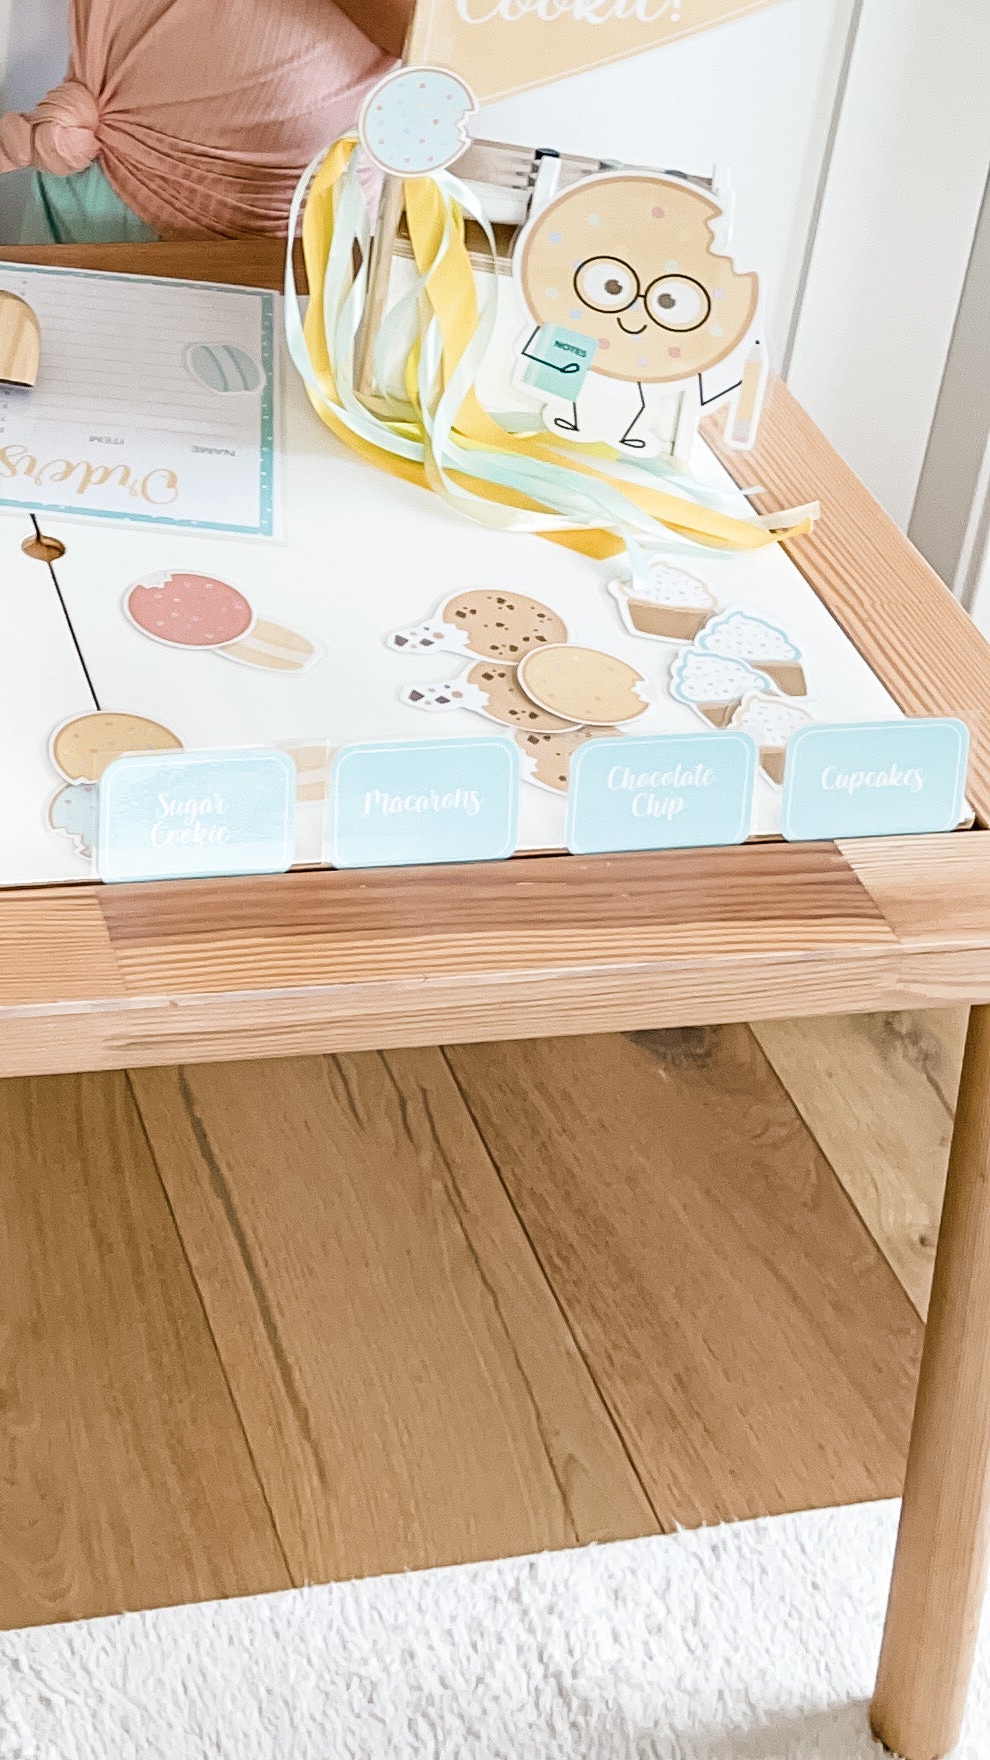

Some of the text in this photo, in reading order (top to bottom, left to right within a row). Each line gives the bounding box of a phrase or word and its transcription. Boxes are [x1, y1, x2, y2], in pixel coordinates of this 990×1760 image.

[554, 340, 587, 357] NOTES
[89, 435, 125, 446] ITEM
[191, 445, 236, 457] NAME
[607, 763, 717, 791] Chocolate
[821, 765, 925, 794] Cupcakes
[158, 792, 227, 826] Sugar
[363, 788, 484, 816] Macarons
[632, 791, 686, 821] Chip
[151, 820, 230, 848] Cookie
